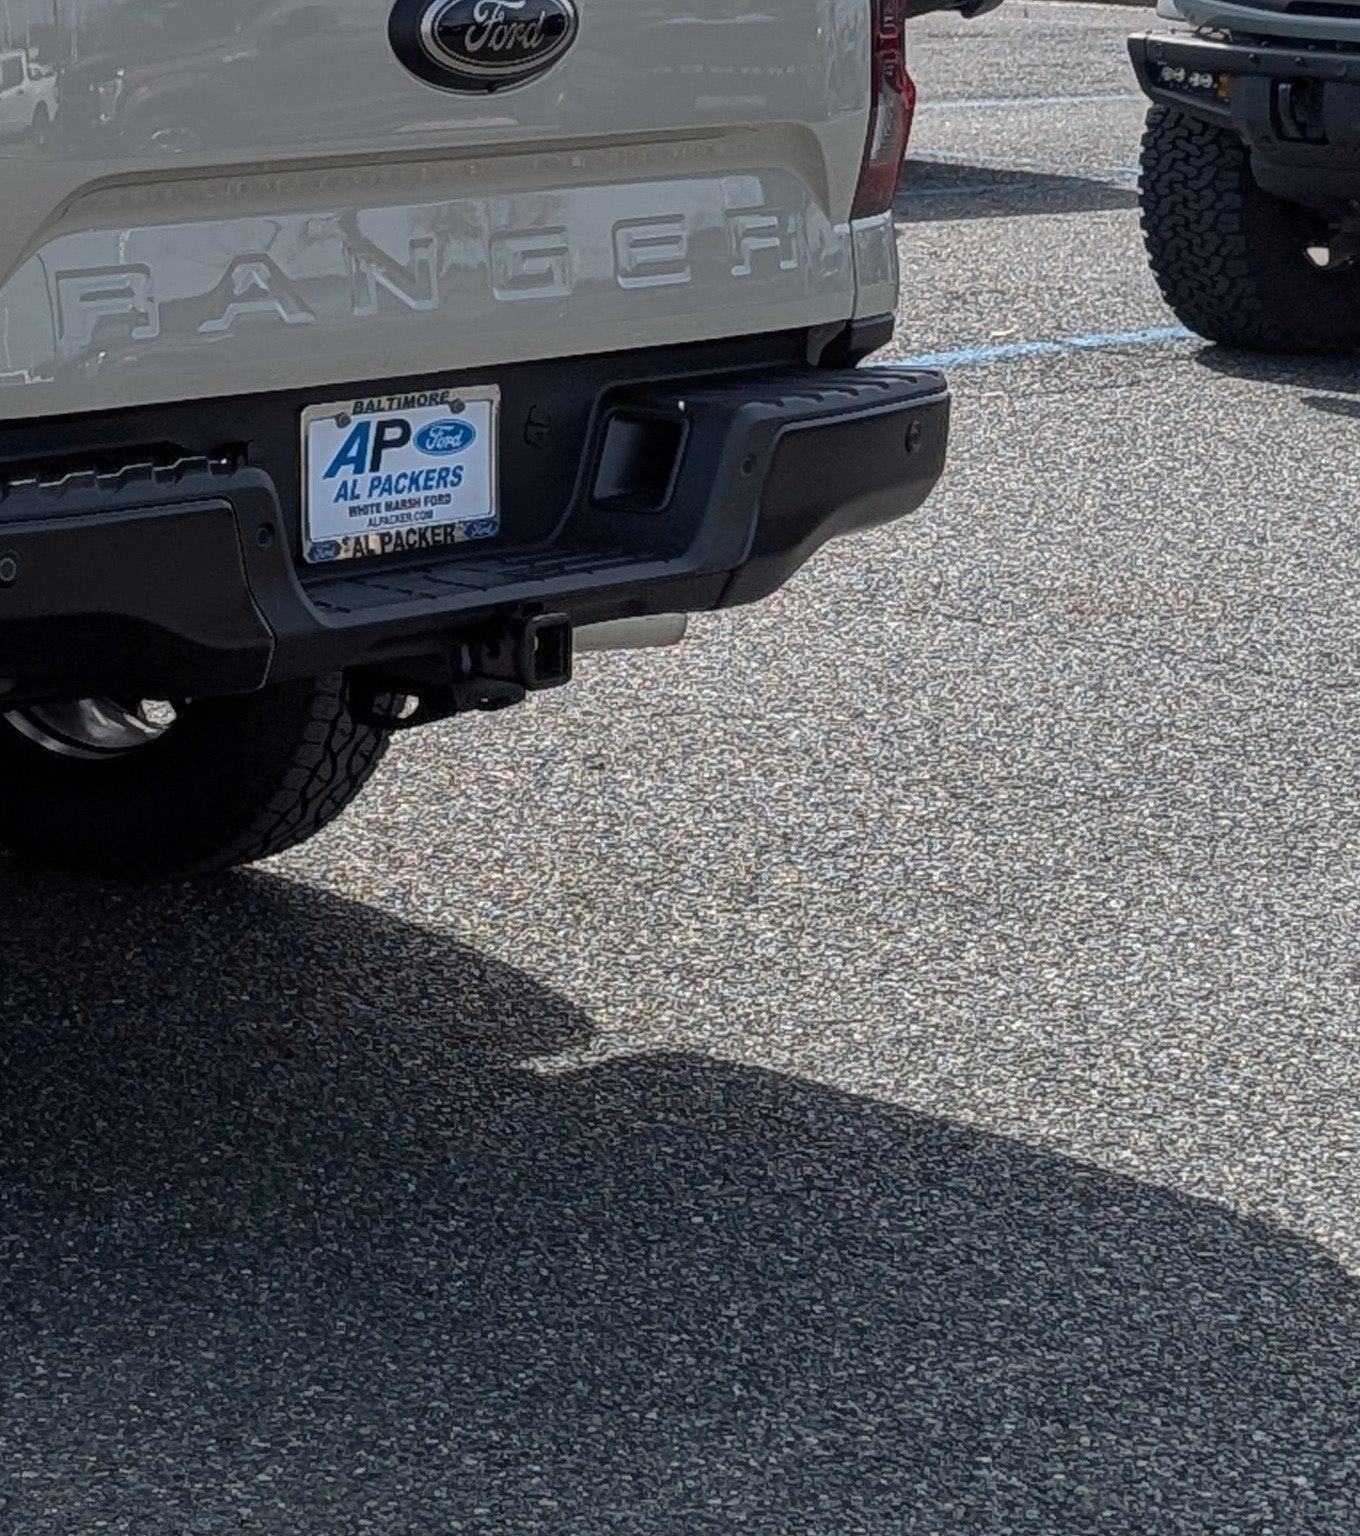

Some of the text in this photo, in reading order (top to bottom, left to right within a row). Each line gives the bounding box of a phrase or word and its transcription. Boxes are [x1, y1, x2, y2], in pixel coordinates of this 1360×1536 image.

[53, 206, 799, 341] RANGER
[353, 391, 450, 413] BALTIMORE
[323, 418, 463, 480] AP Ford
[333, 465, 465, 503] AL PACKERS
[348, 493, 453, 518] WHITE MARSH FORD
[352, 537, 376, 558] AL
[381, 524, 456, 553] PACKER
